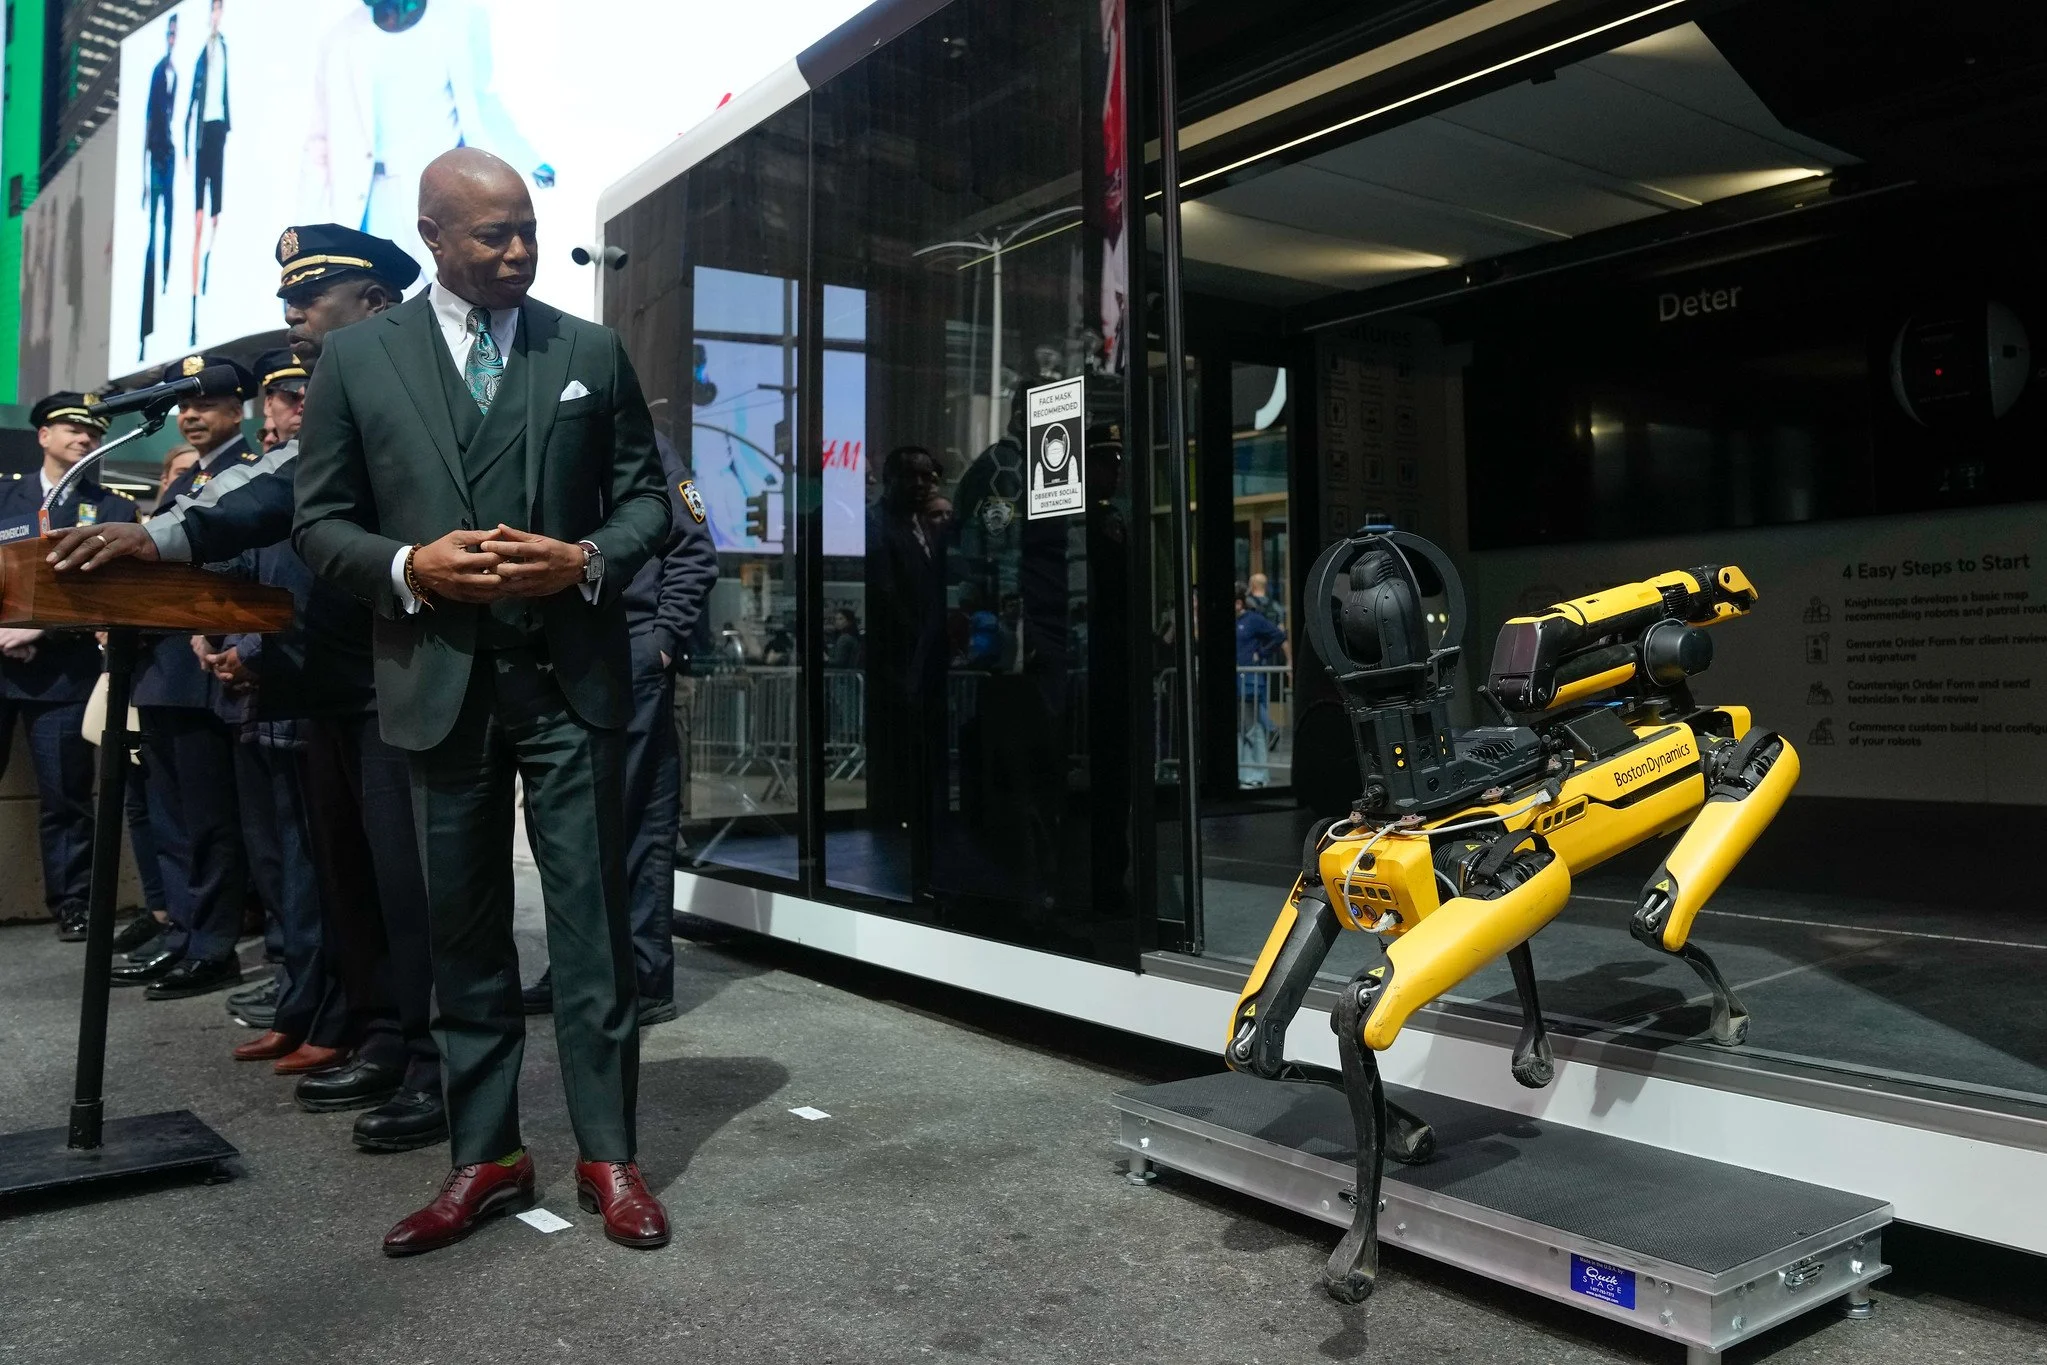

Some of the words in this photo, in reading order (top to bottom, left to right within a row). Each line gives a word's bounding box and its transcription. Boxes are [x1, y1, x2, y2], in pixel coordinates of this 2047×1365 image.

[1658, 285, 1743, 322] Deter
[1039, 396, 1053, 404] FACE
[1055, 391, 1072, 401] MASK
[1033, 401, 1078, 417] RECOMMENDED
[1035, 491, 1058, 499] OBSERVE
[1060, 488, 1078, 496] SOCIAL
[1041, 498, 1072, 508] DISTANCING
[1842, 564, 1852, 579] 4
[1857, 563, 1896, 580] Easy
[1902, 559, 1952, 577] Steps
[1957, 558, 1976, 572] to
[1982, 553, 2030, 571] Start
[1845, 597, 1908, 609] Knightscope
[1911, 595, 1958, 605] develops
[1971, 591, 2000, 601] basic
[2004, 591, 2028, 601] map
[1845, 610, 1921, 621] recommending
[1925, 608, 1959, 617] robots
[1962, 606, 1983, 617] and
[1986, 604, 2020, 617] patrol
[1846, 639, 1891, 649] Generate
[1895, 637, 1925, 647] Order
[1929, 636, 1957, 646] Form
[1960, 636, 1976, 646] for
[1979, 635, 2009, 645] client
[1847, 653, 1865, 662] and
[1868, 652, 1916, 664] signature
[1848, 680, 1910, 691] Countersign
[1913, 679, 1943, 689] Order
[1947, 679, 1976, 689] Form
[1978, 679, 1999, 689] and
[2002, 679, 2030, 689] send
[1848, 694, 1899, 704] technician
[1903, 695, 1916, 703] for
[1920, 694, 1939, 703] site
[1942, 695, 1979, 703] review
[1849, 721, 1905, 732] Commence
[1908, 723, 1947, 732] custom
[1950, 722, 1978, 732] build
[1981, 723, 2002, 732] and
[1849, 736, 1859, 745] of
[1862, 738, 1885, 747] your
[1887, 737, 1922, 746] robots
[1614, 743, 1690, 787] BostonDynamics
[1586, 1266, 1618, 1285] Quik
[1582, 1276, 1622, 1294] STAGE
